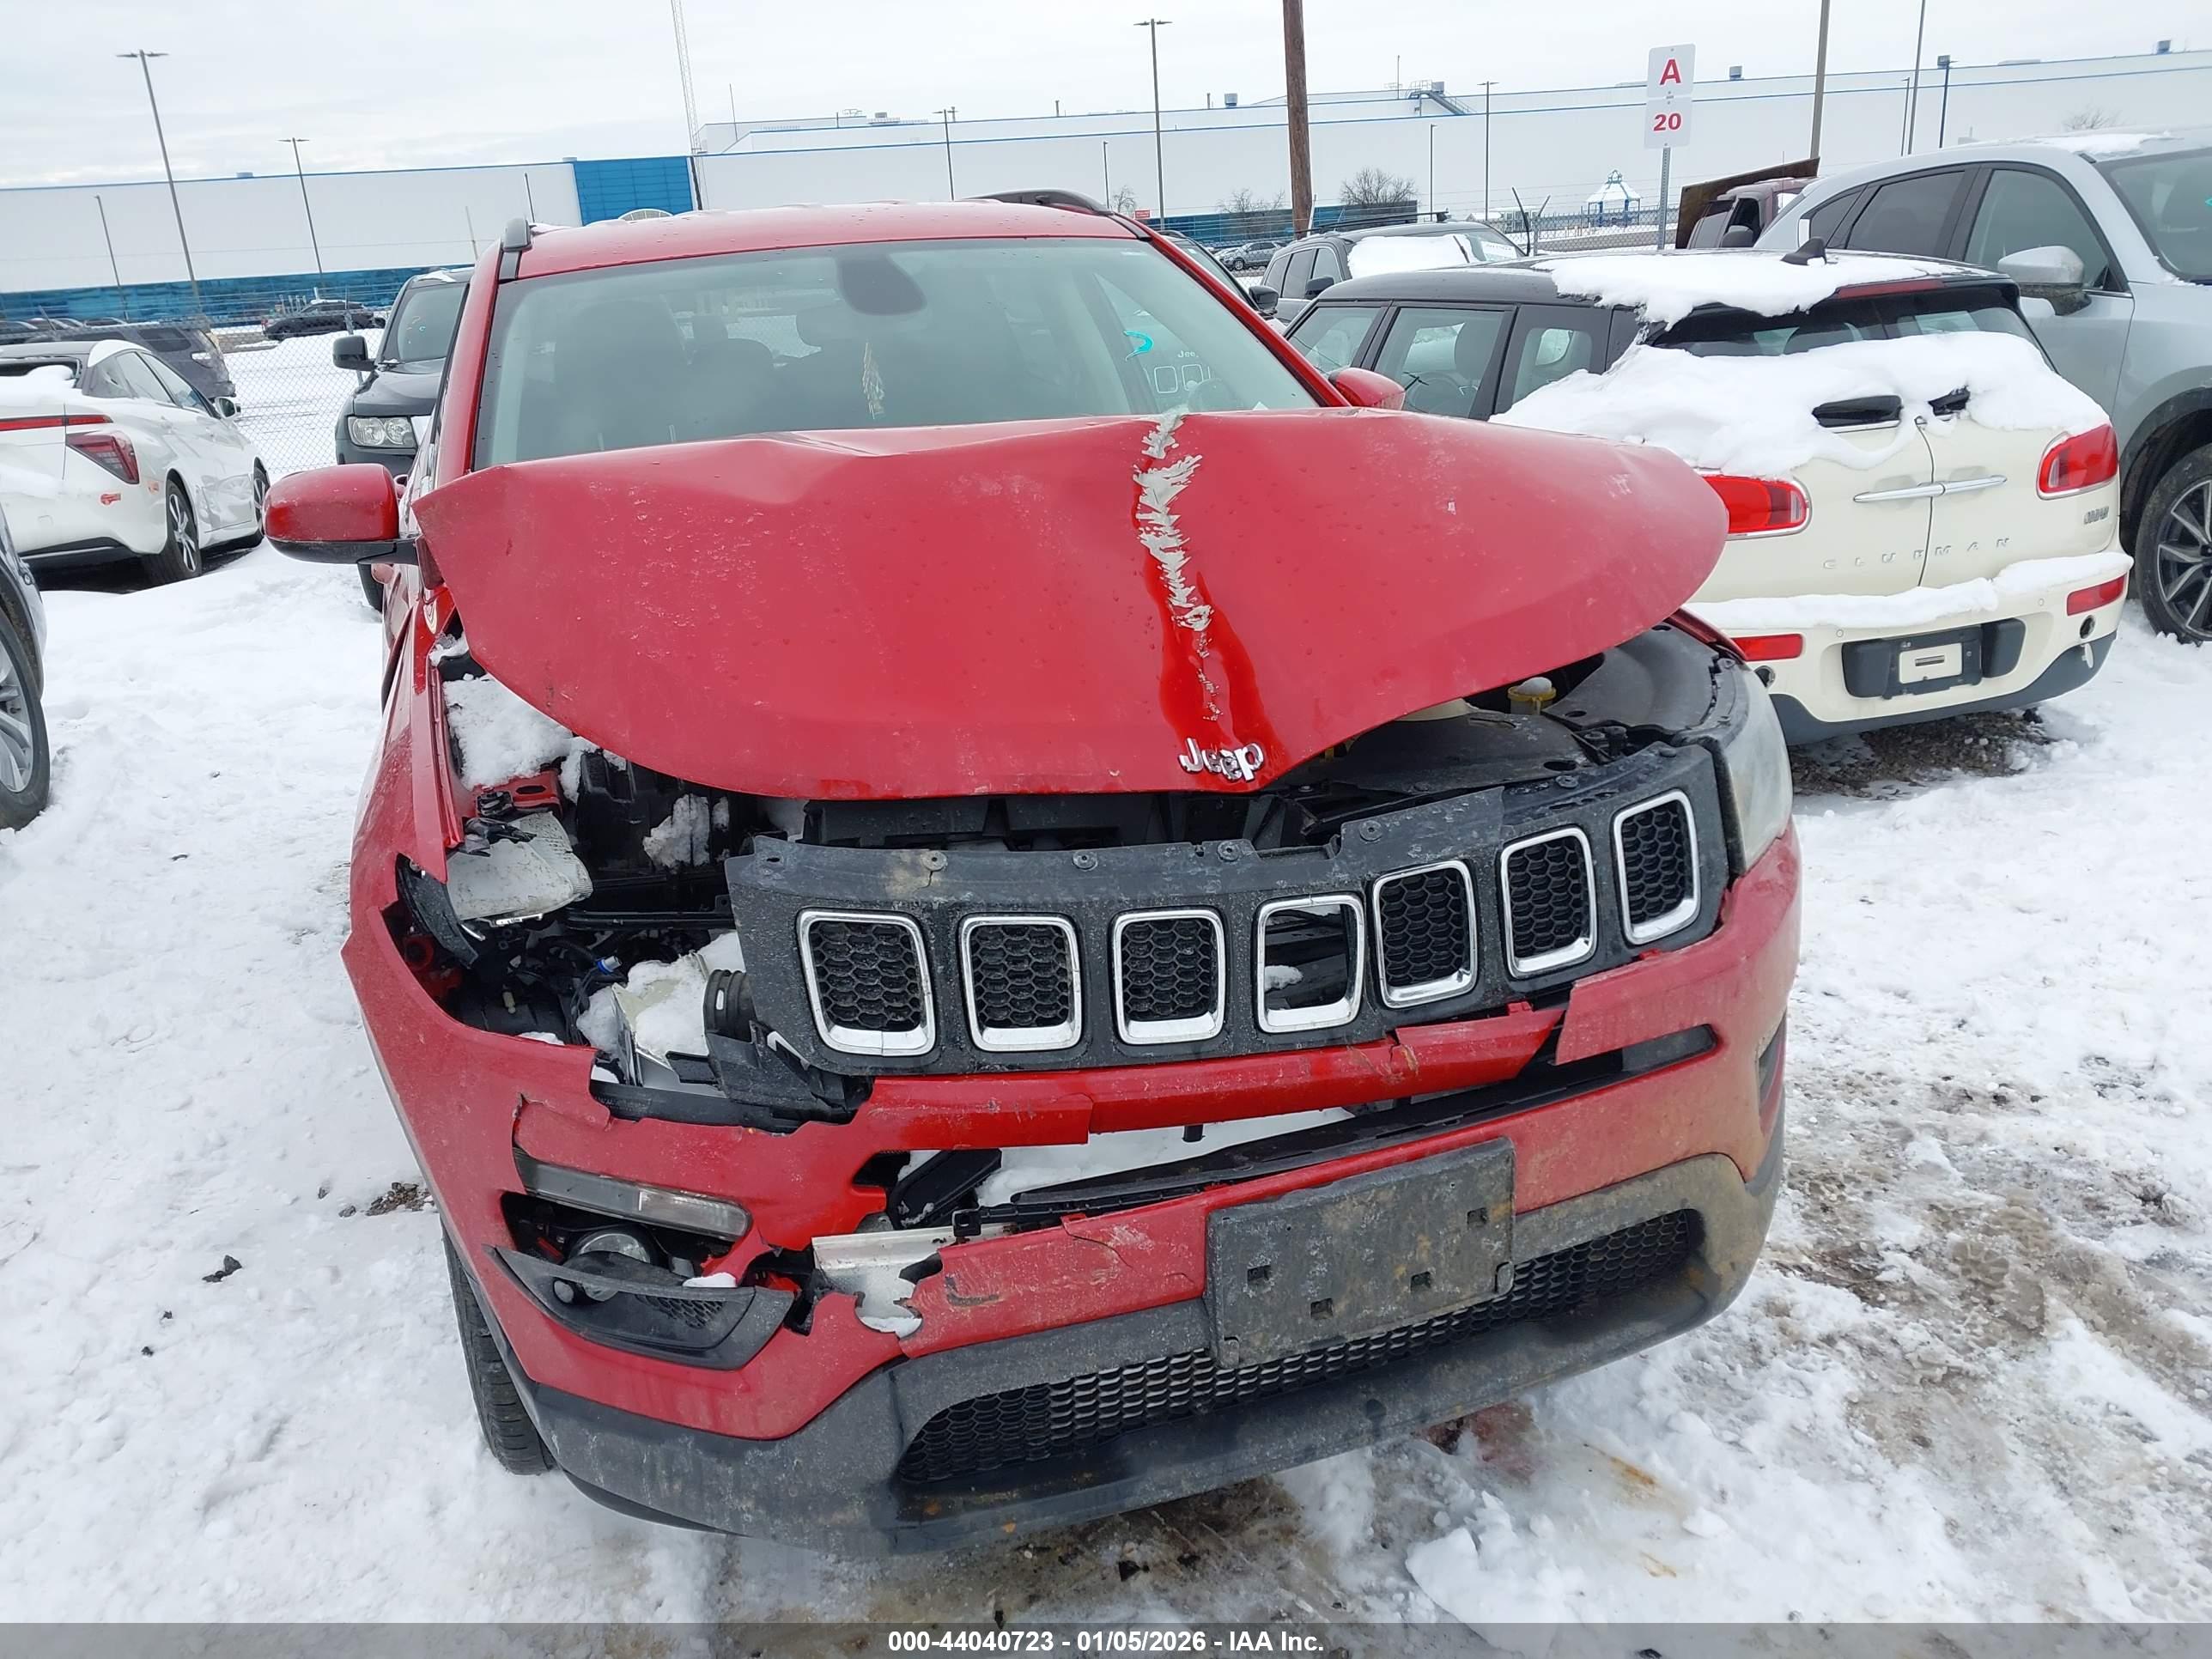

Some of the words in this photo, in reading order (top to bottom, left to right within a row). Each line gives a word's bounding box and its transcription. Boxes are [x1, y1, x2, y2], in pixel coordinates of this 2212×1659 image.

[1660, 58, 1681, 85] A
[1654, 112, 1681, 131] 20
[1178, 737, 1264, 781] Jeep
